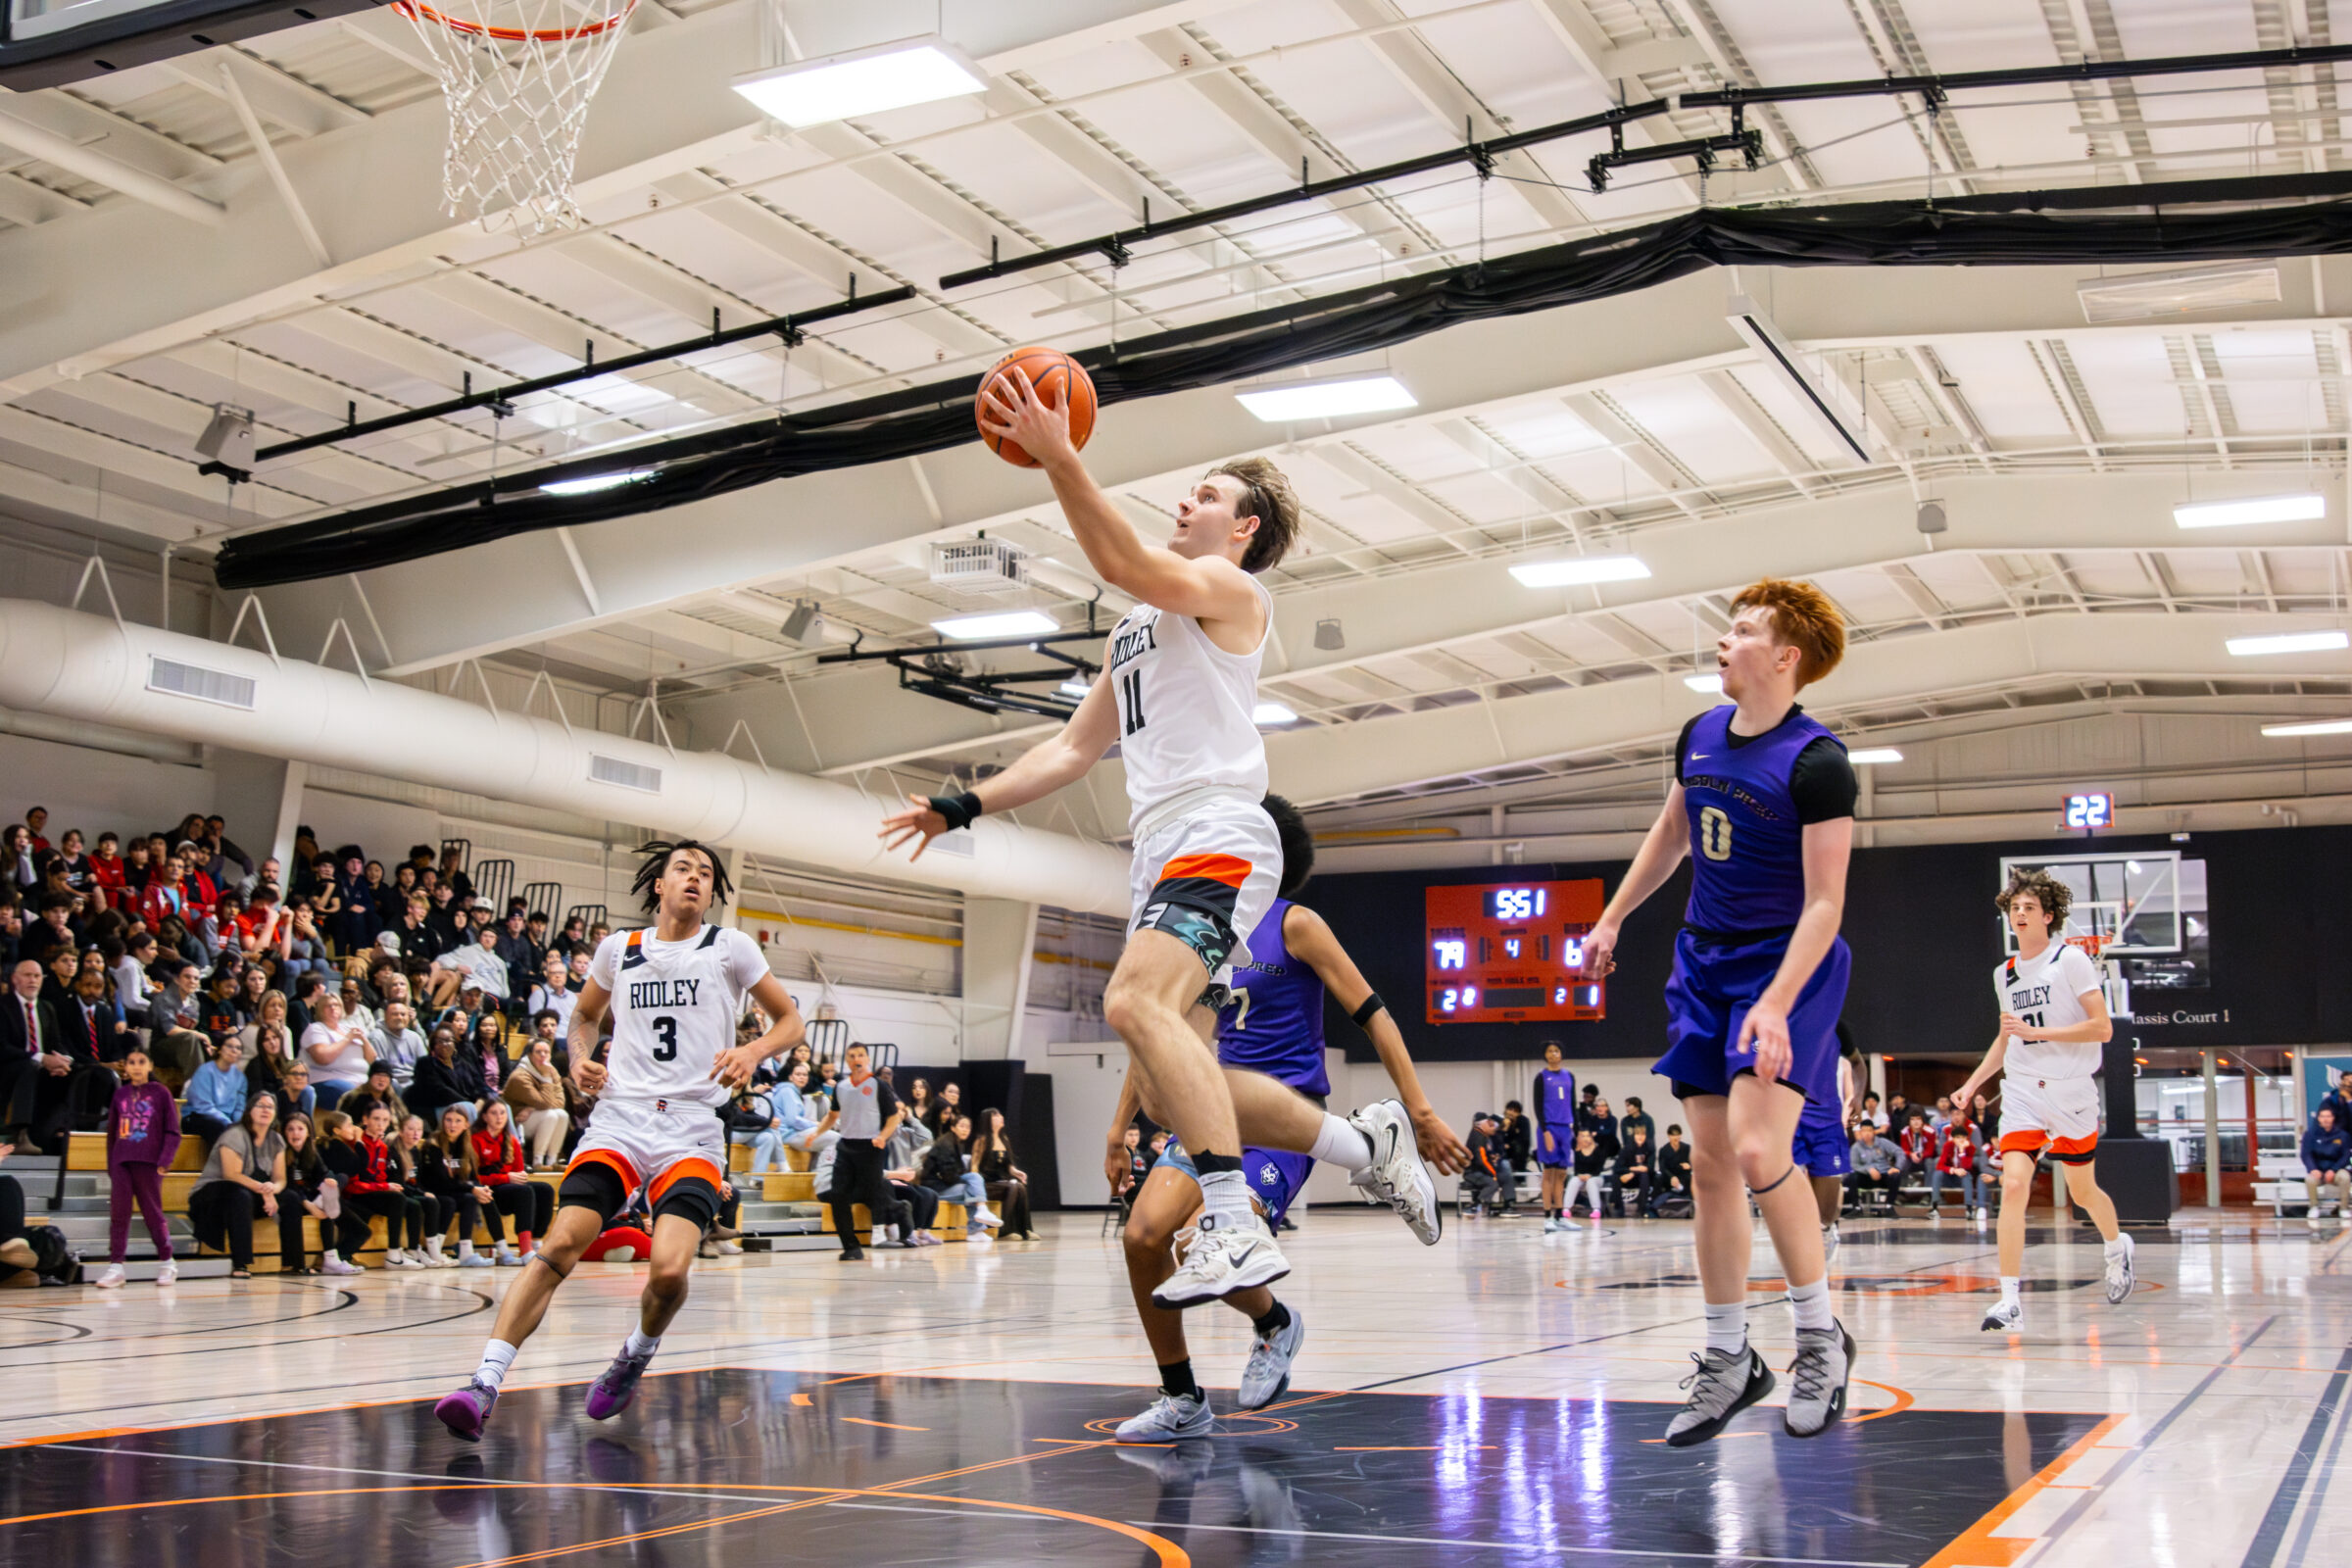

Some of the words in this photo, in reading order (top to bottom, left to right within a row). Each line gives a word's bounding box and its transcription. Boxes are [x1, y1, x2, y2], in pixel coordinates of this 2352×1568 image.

[1123, 667, 1147, 737] 11
[2068, 794, 2107, 827] 22
[1700, 806, 1733, 861] 0
[1433, 940, 1465, 970] 79
[1505, 939, 1521, 958] 4
[1564, 937, 1588, 967] 6
[630, 979, 700, 1009] RIDLEY
[1442, 989, 1457, 1011] 2
[1554, 987, 1567, 1004] 2
[1588, 984, 1599, 1007] 1
[2012, 985, 2051, 1011] RIDLEY
[2172, 1009, 2219, 1024] Court
[2223, 1008, 2231, 1023] 1
[653, 1015, 678, 1062] 3
